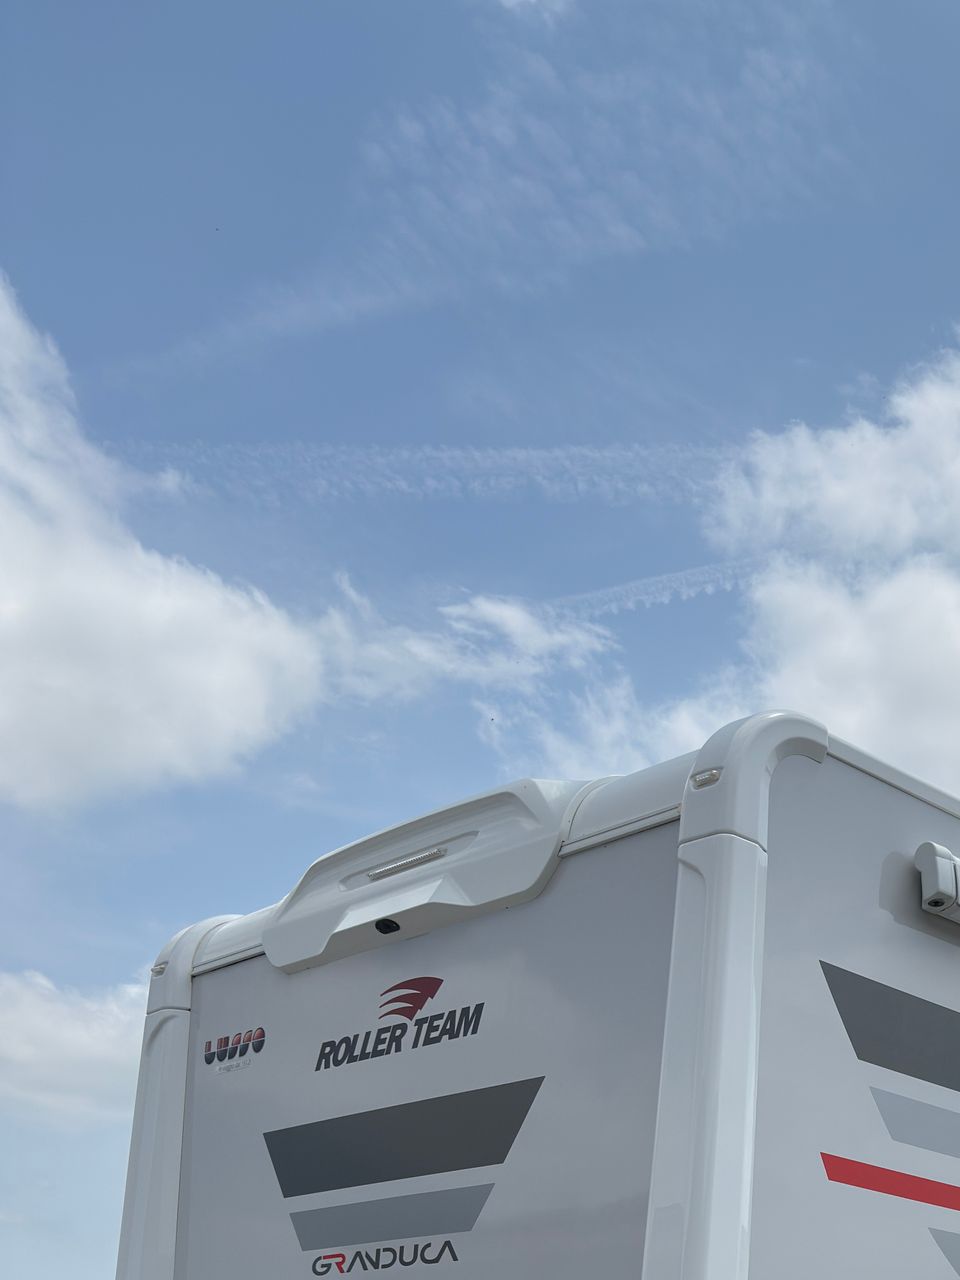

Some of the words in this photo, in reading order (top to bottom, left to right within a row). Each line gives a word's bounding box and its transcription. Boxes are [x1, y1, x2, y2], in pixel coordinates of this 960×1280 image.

[315, 1023, 409, 1072] ROLLER
[411, 1002, 486, 1050] TEAM
[311, 1240, 459, 1276] GRANDUCA
